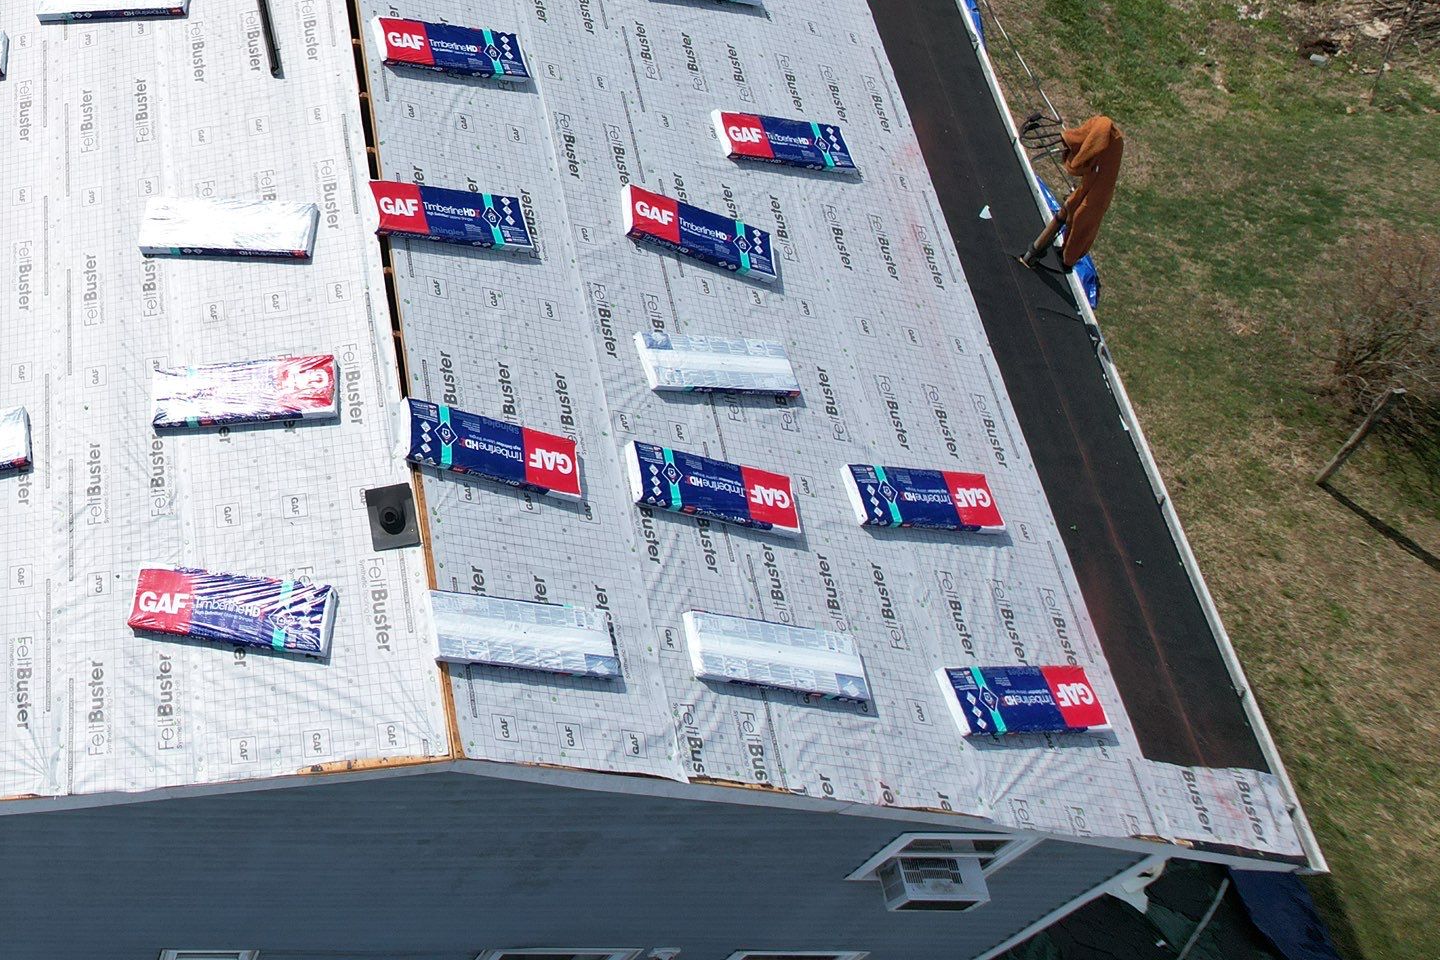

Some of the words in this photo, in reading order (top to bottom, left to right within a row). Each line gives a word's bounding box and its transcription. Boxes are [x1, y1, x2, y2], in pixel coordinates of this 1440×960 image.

[191, 22, 205, 83] FeltBuster
[247, 10, 261, 72] FeltBuster
[388, 31, 424, 50] GAF
[637, 22, 658, 80] FeltBuster
[681, 32, 704, 92] FeltBuster
[136, 78, 148, 143] FeltBuster
[779, 54, 804, 113] FeltBuster
[864, 76, 891, 134] FeltBuster
[81, 89, 93, 154] FeltBuster
[559, 112, 580, 180] FeltBuster
[728, 124, 763, 144] GAF
[320, 159, 339, 230] FeltBuster
[380, 197, 419, 216] GAF
[635, 201, 674, 226] GAF
[431, 227, 464, 236] Shingles
[825, 205, 853, 271] FeltBuster
[915, 224, 945, 291] FeltBuster
[18, 240, 32, 312] FeltBuster
[84, 254, 97, 326] FeltBuster
[593, 282, 617, 358] FeltBuster
[342, 343, 364, 425] FeltBuster
[817, 366, 845, 441] FeltBuster
[878, 375, 910, 451] FeltBuster
[529, 448, 573, 474] GAF
[973, 394, 1007, 469] FeltBuster
[222, 507, 232, 524] GAF
[289, 498, 299, 514] GAF
[751, 482, 791, 511] GAF
[955, 485, 991, 508] GAF
[17, 568, 25, 583] GAF
[139, 591, 190, 614] GAF
[367, 558, 390, 652] FeltBuster
[872, 562, 909, 650] FeltBuster
[939, 570, 977, 658] FeltBuster
[17, 637, 32, 729] FeltBuster
[88, 661, 104, 756] FeltBuster
[156, 654, 174, 750] FeltBuster
[1058, 683, 1094, 708] GAF
[238, 740, 248, 760] GAF
[312, 733, 321, 752] GAF
[386, 725, 396, 744] GAF
[501, 717, 512, 738] GAF
[566, 726, 577, 746] GAF
[632, 734, 643, 754] GAF
